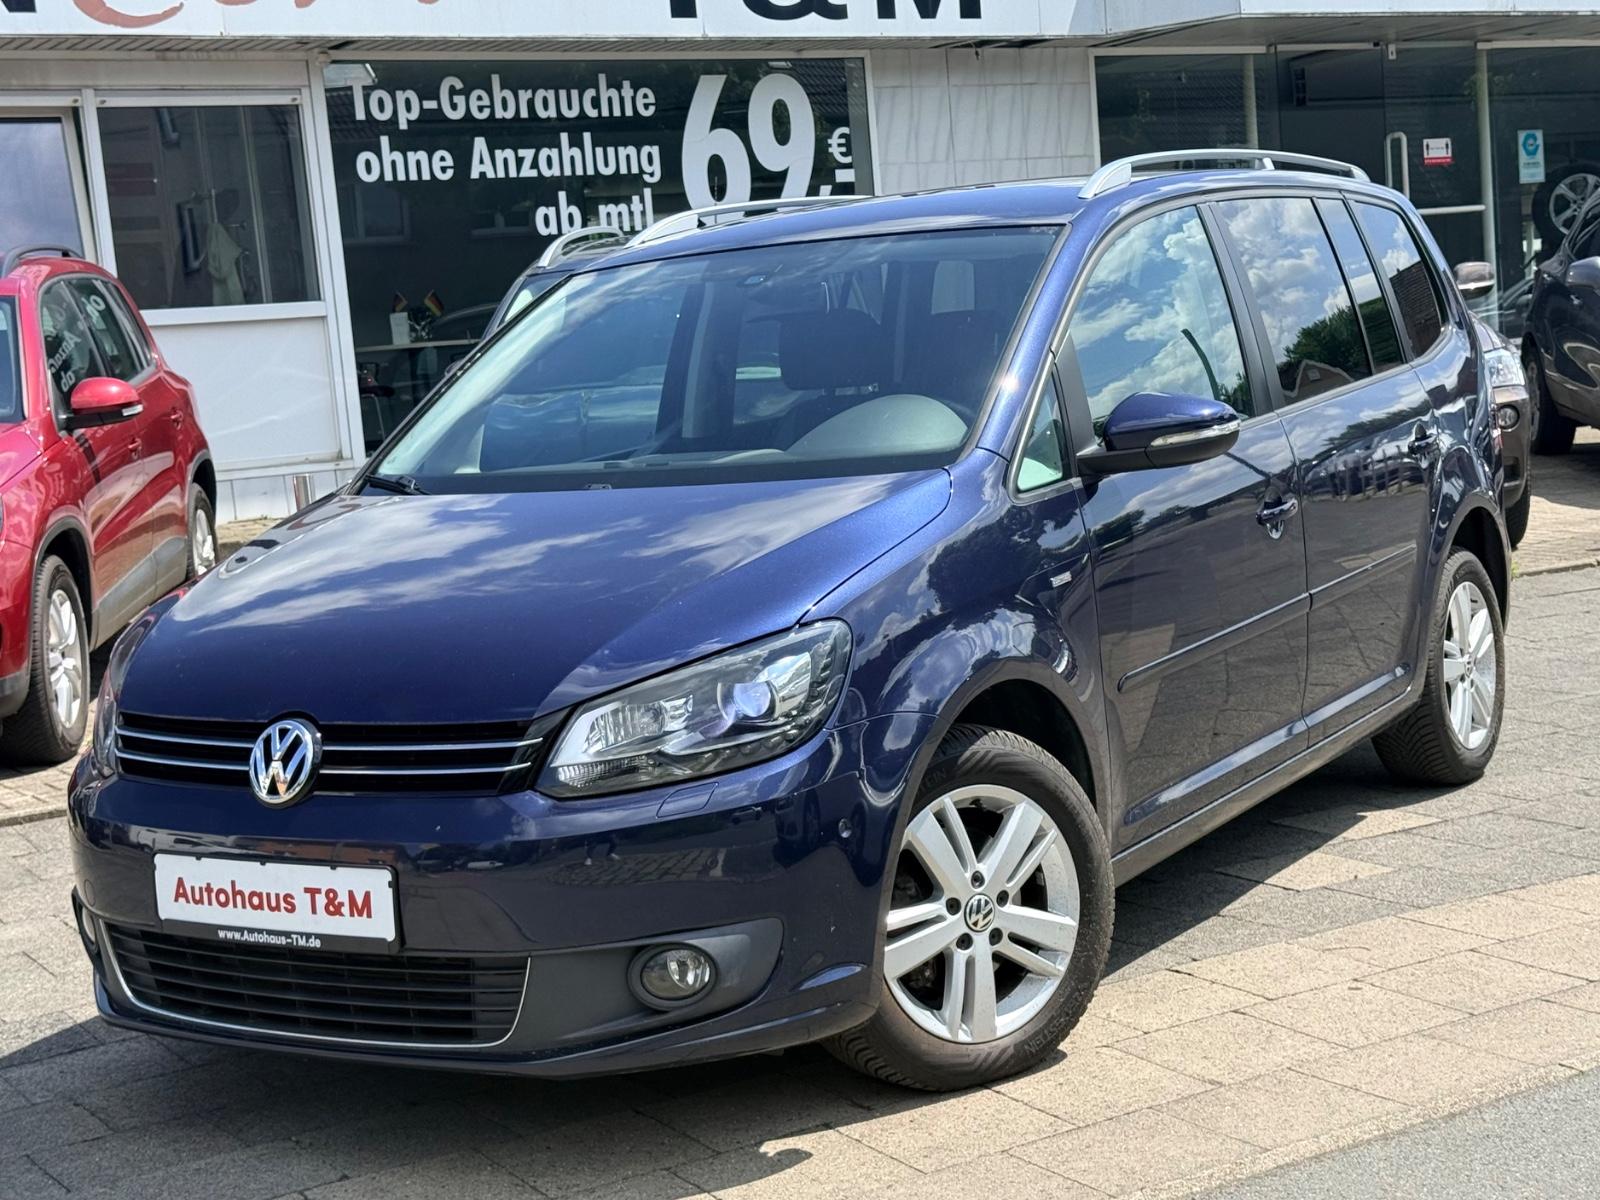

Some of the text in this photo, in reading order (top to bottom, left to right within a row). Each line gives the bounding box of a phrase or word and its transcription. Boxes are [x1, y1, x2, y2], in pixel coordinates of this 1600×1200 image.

[351, 73, 656, 130] Top-Gebrauchte
[356, 131, 662, 183] ohne Anzahlung
[535, 187, 655, 236] ab mtl
[174, 877, 373, 919] Autohaus T&M
[217, 928, 322, 949] www.Autohaus-TM.de
